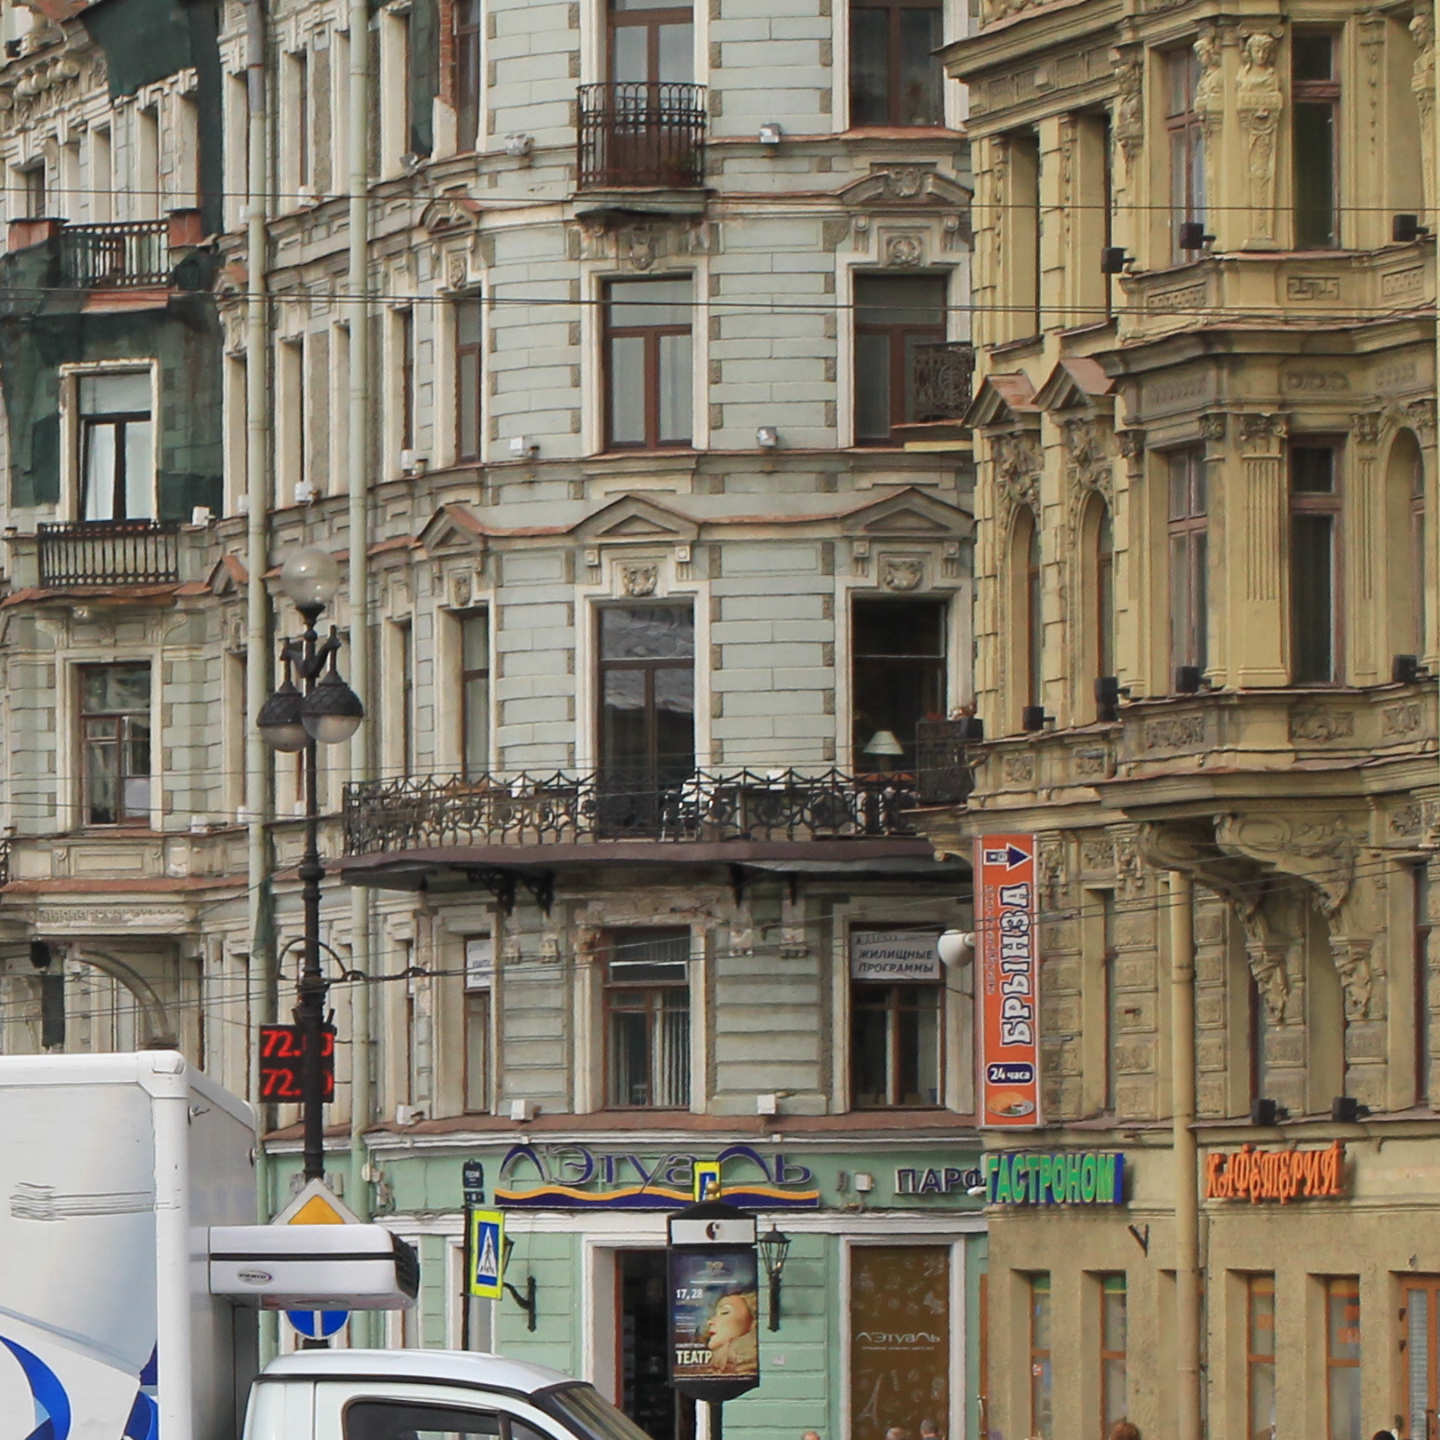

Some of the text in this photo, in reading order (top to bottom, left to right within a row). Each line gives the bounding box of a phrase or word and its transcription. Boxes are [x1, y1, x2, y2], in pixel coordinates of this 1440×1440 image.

[859, 949, 933, 961] ЖИЛИЩНЫЕ
[858, 963, 934, 973] ПРОГРАММЫ
[1001, 883, 1033, 1045] БРЫНЗА
[990, 1067, 1030, 1080] 24 часа
[986, 1153, 1116, 1204] ГАСТРОНОМ
[676, 1350, 713, 1365] ТЕАТР
